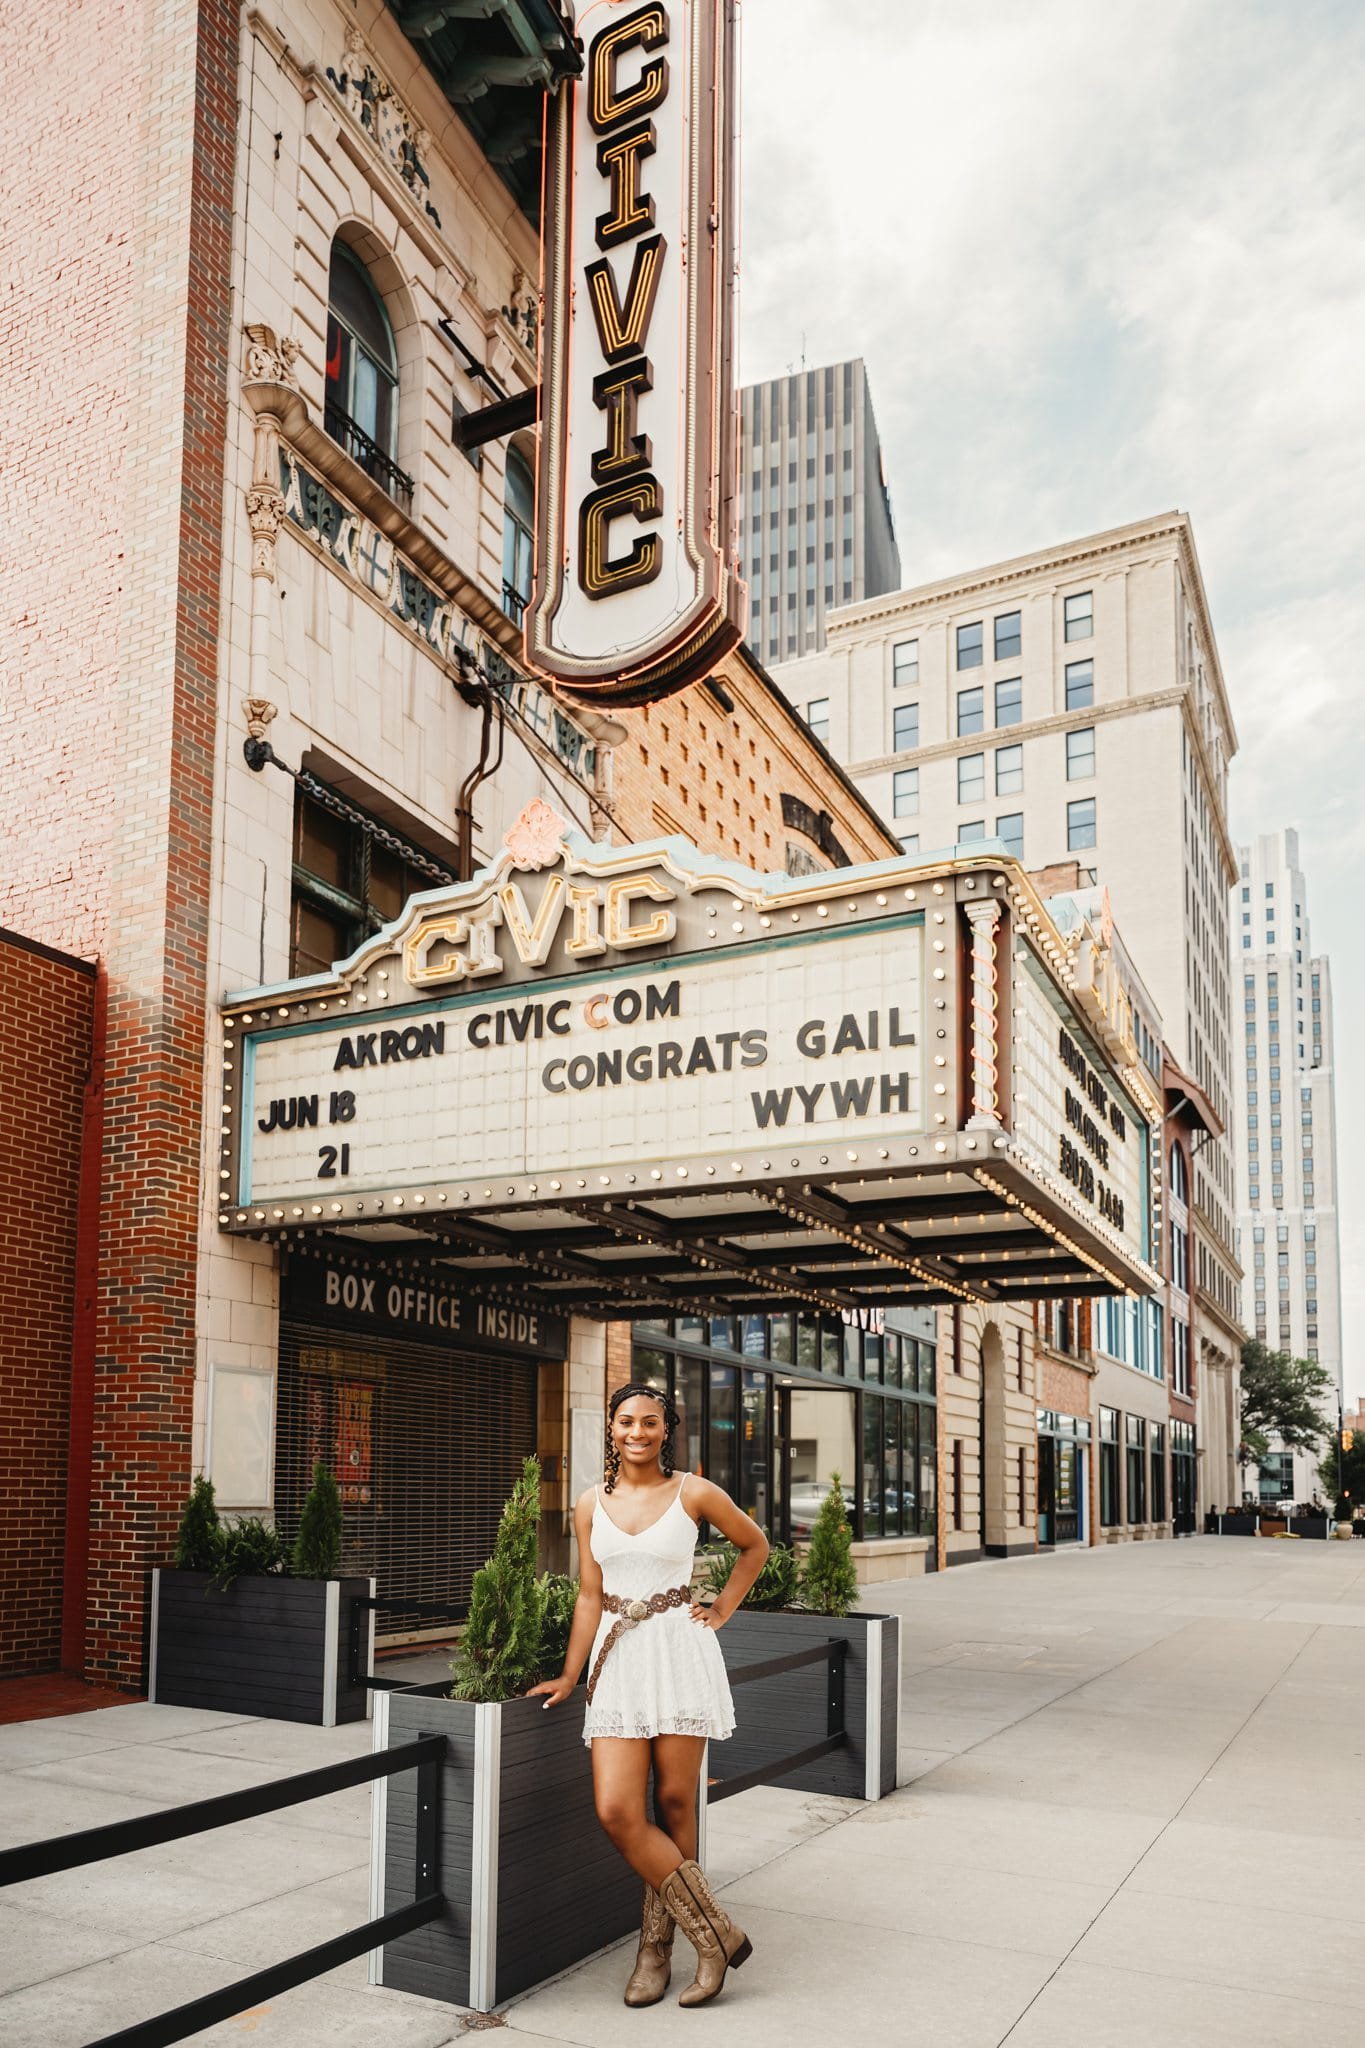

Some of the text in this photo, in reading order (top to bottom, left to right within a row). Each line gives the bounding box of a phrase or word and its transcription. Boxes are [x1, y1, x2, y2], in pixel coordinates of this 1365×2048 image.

[578, 1, 671, 600] CIVIC
[402, 873, 677, 989] CIVIC
[333, 980, 680, 1071] AKRON CIVIC COM
[541, 1007, 915, 1093] CONGRATS GAIL
[258, 1090, 356, 1133] JUN 18
[751, 1071, 909, 1128] WYWH
[317, 1143, 350, 1178] 21
[326, 1270, 538, 1344] BOX OFFICE INSIDE
